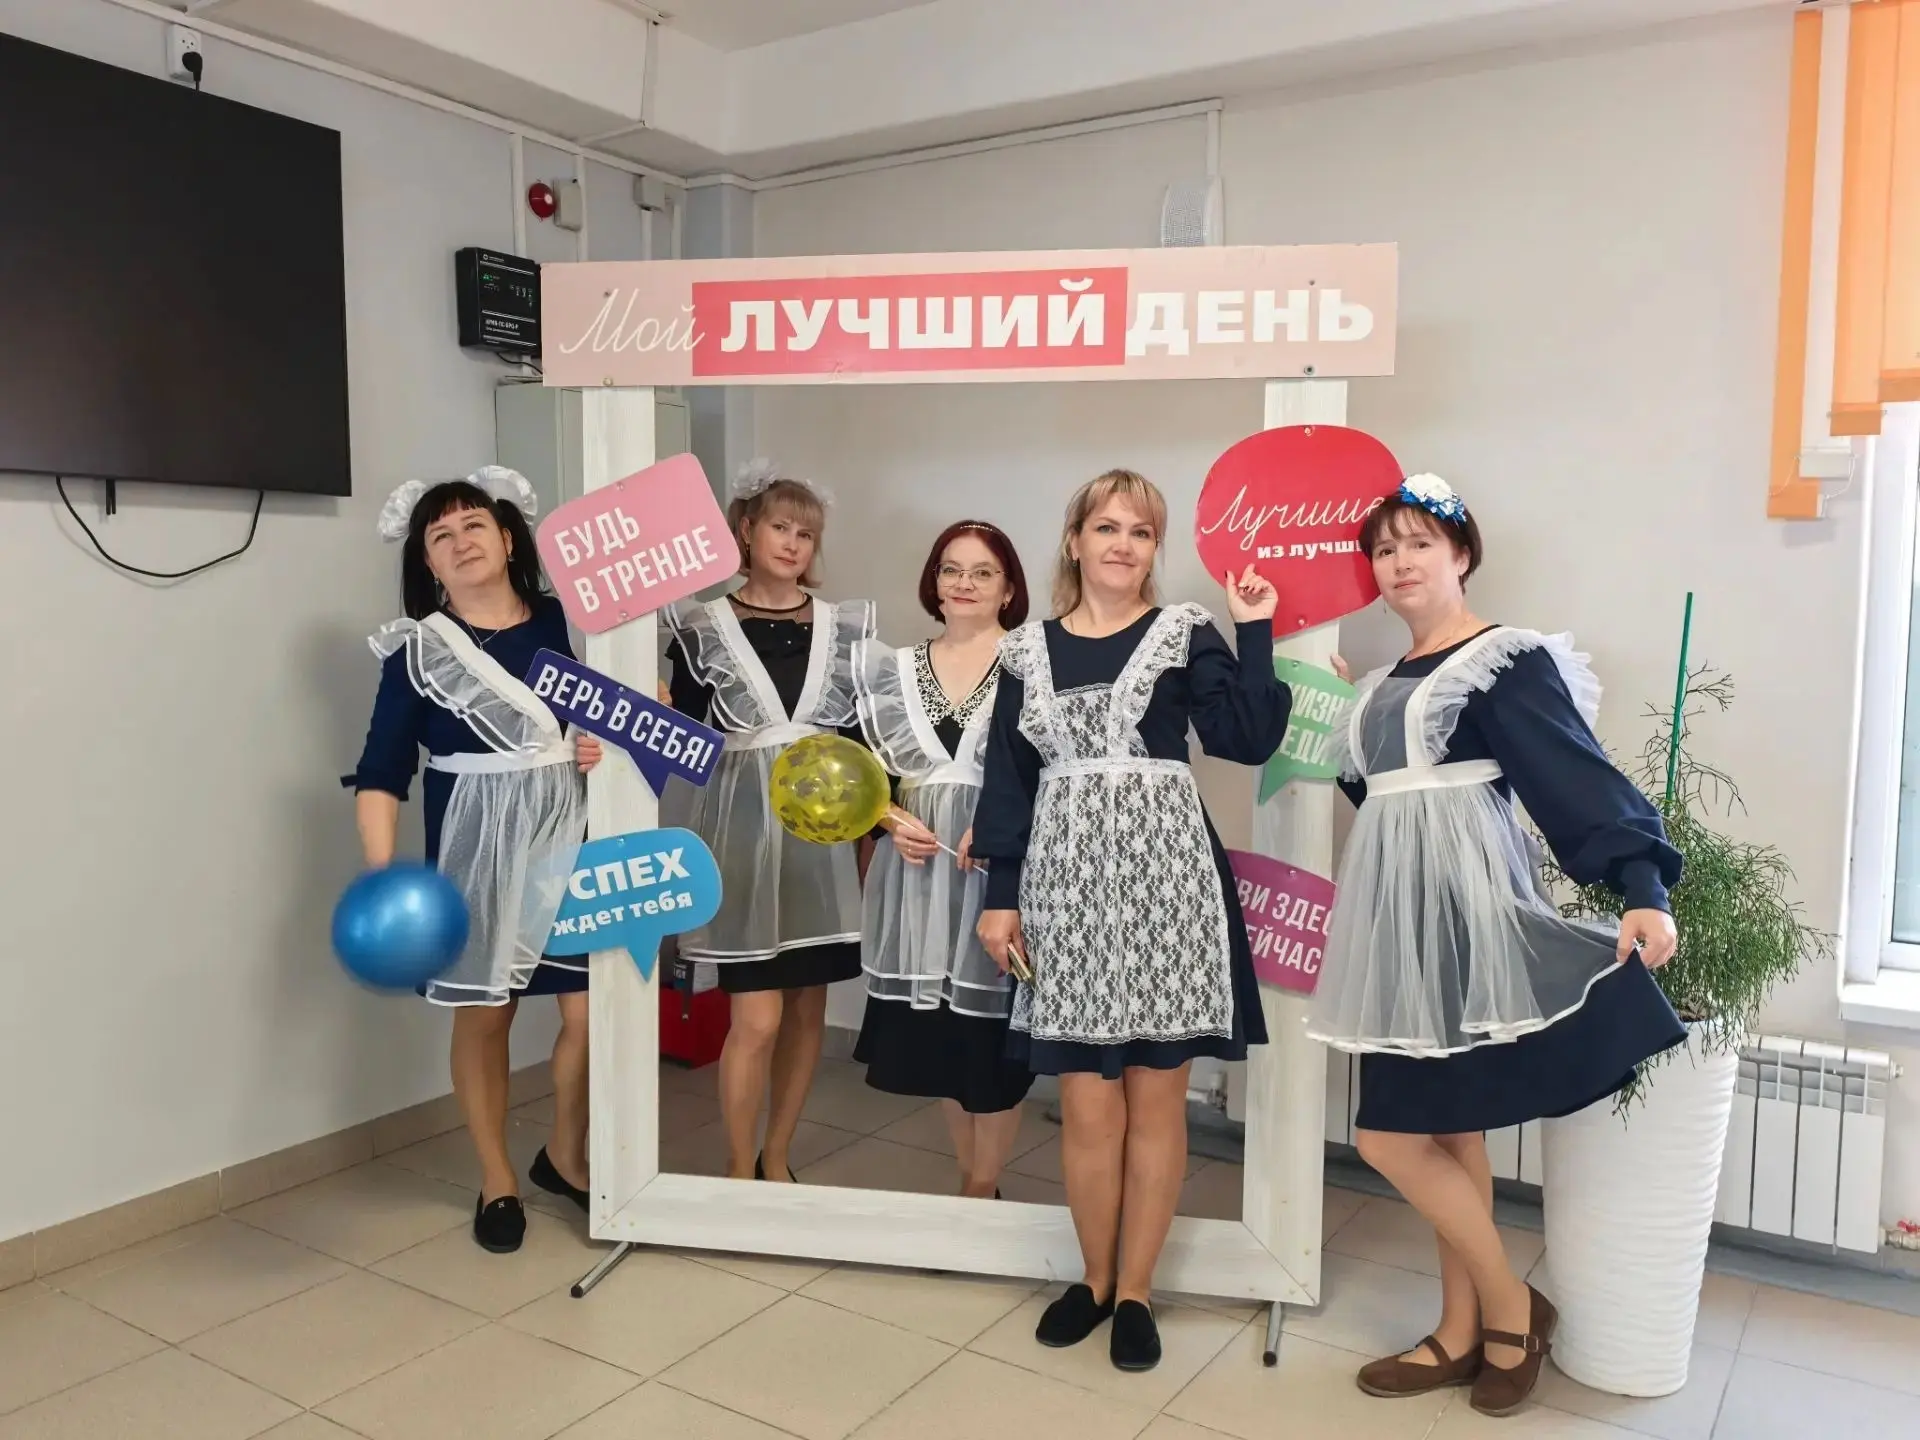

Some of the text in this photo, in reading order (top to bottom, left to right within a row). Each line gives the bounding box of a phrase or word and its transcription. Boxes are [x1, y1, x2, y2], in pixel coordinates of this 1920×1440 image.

[559, 276, 1375, 357] Мой ЛУЧШИЙ ДЕНЬ
[554, 507, 641, 568] БУДЬ
[1256, 539, 1363, 561] из лучш
[573, 524, 719, 614] В ТРЕНДЕ
[533, 663, 715, 774] ВЕРЬ В СЕБЯ!
[552, 890, 693, 937] ждет тебя
[1235, 877, 1271, 914] ВИ
